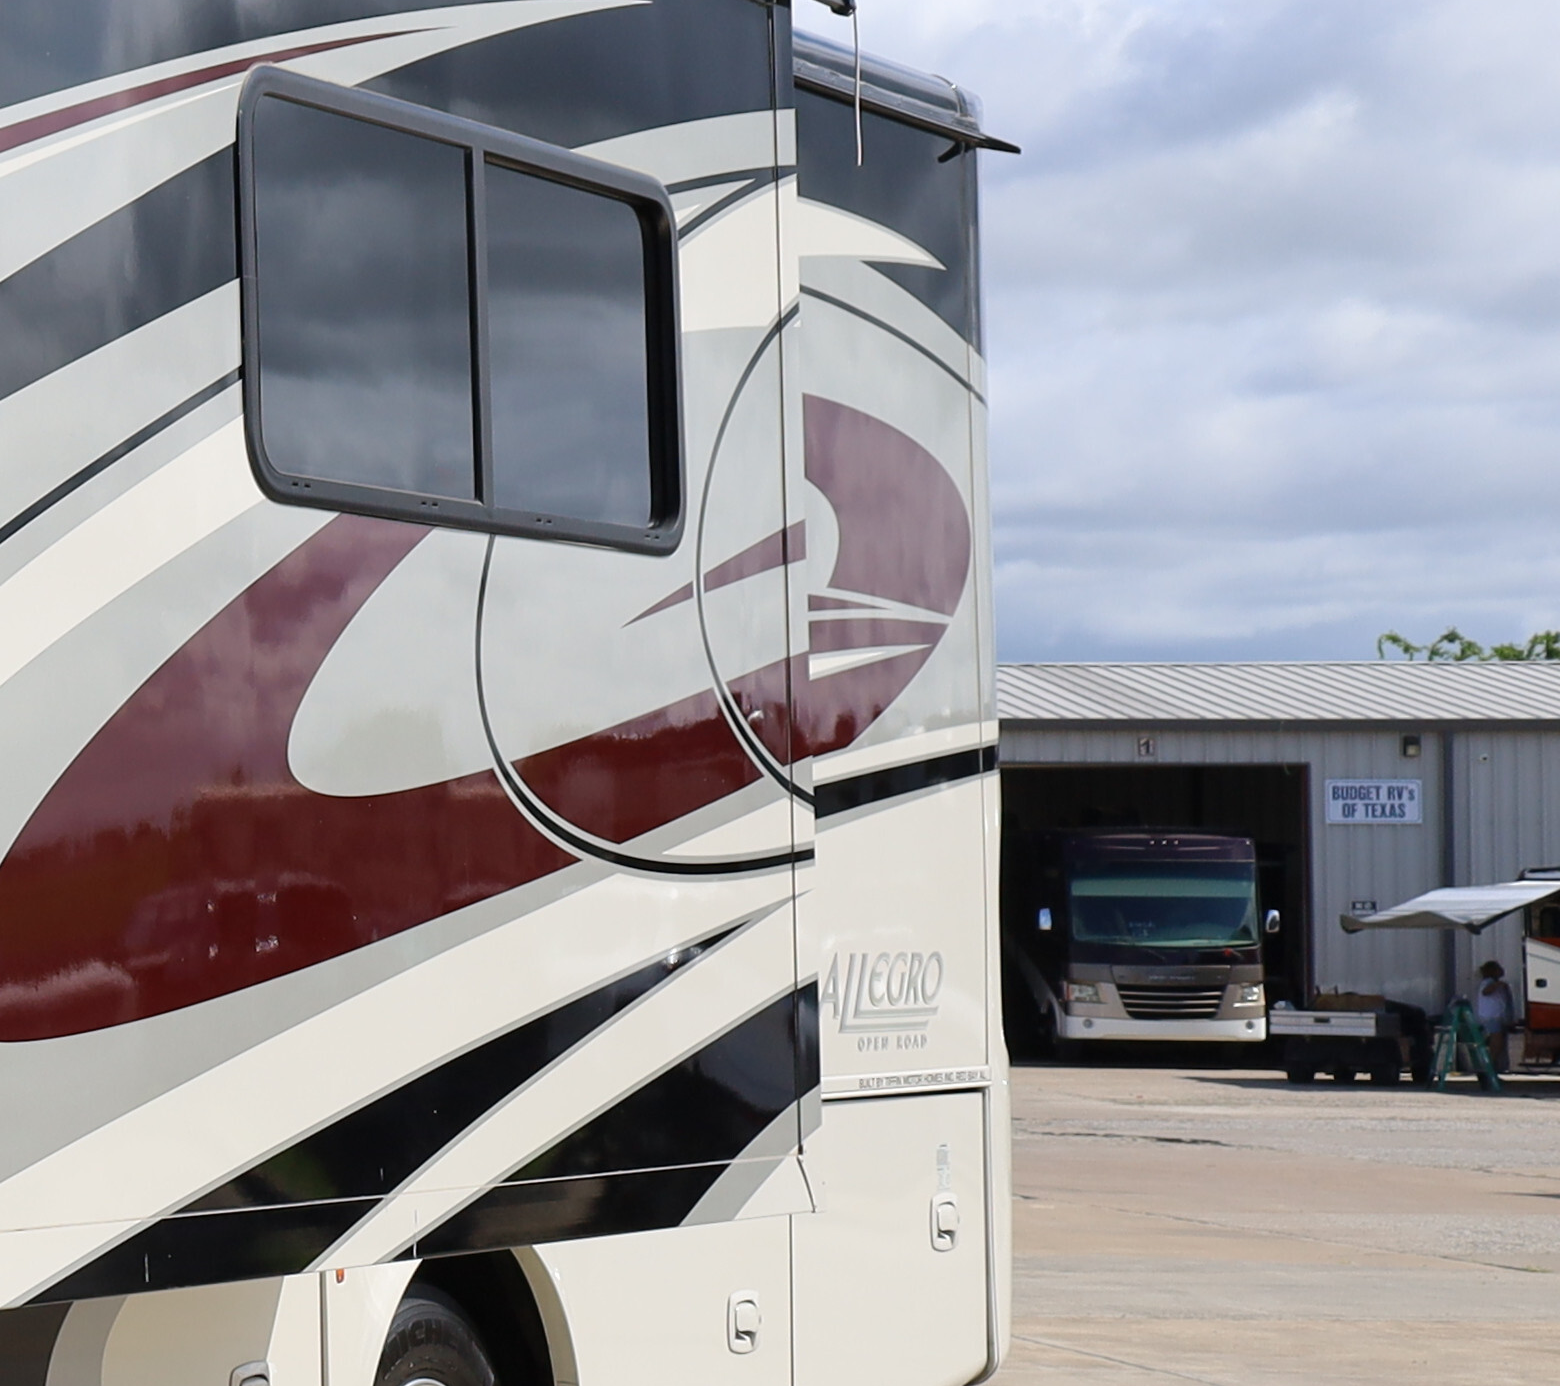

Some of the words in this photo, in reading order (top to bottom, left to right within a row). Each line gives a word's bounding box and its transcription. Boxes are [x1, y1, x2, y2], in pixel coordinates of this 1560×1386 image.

[1331, 784, 1383, 802] BUDGET
[1386, 784, 1416, 802] RV's
[1341, 802, 1359, 819] OF
[1364, 802, 1407, 819] TEXAS
[819, 951, 944, 1033] ALLEGRO
[856, 1035, 889, 1052] OPEN
[896, 1034, 927, 1050] ROAD
[858, 1077, 875, 1089] BUILT
